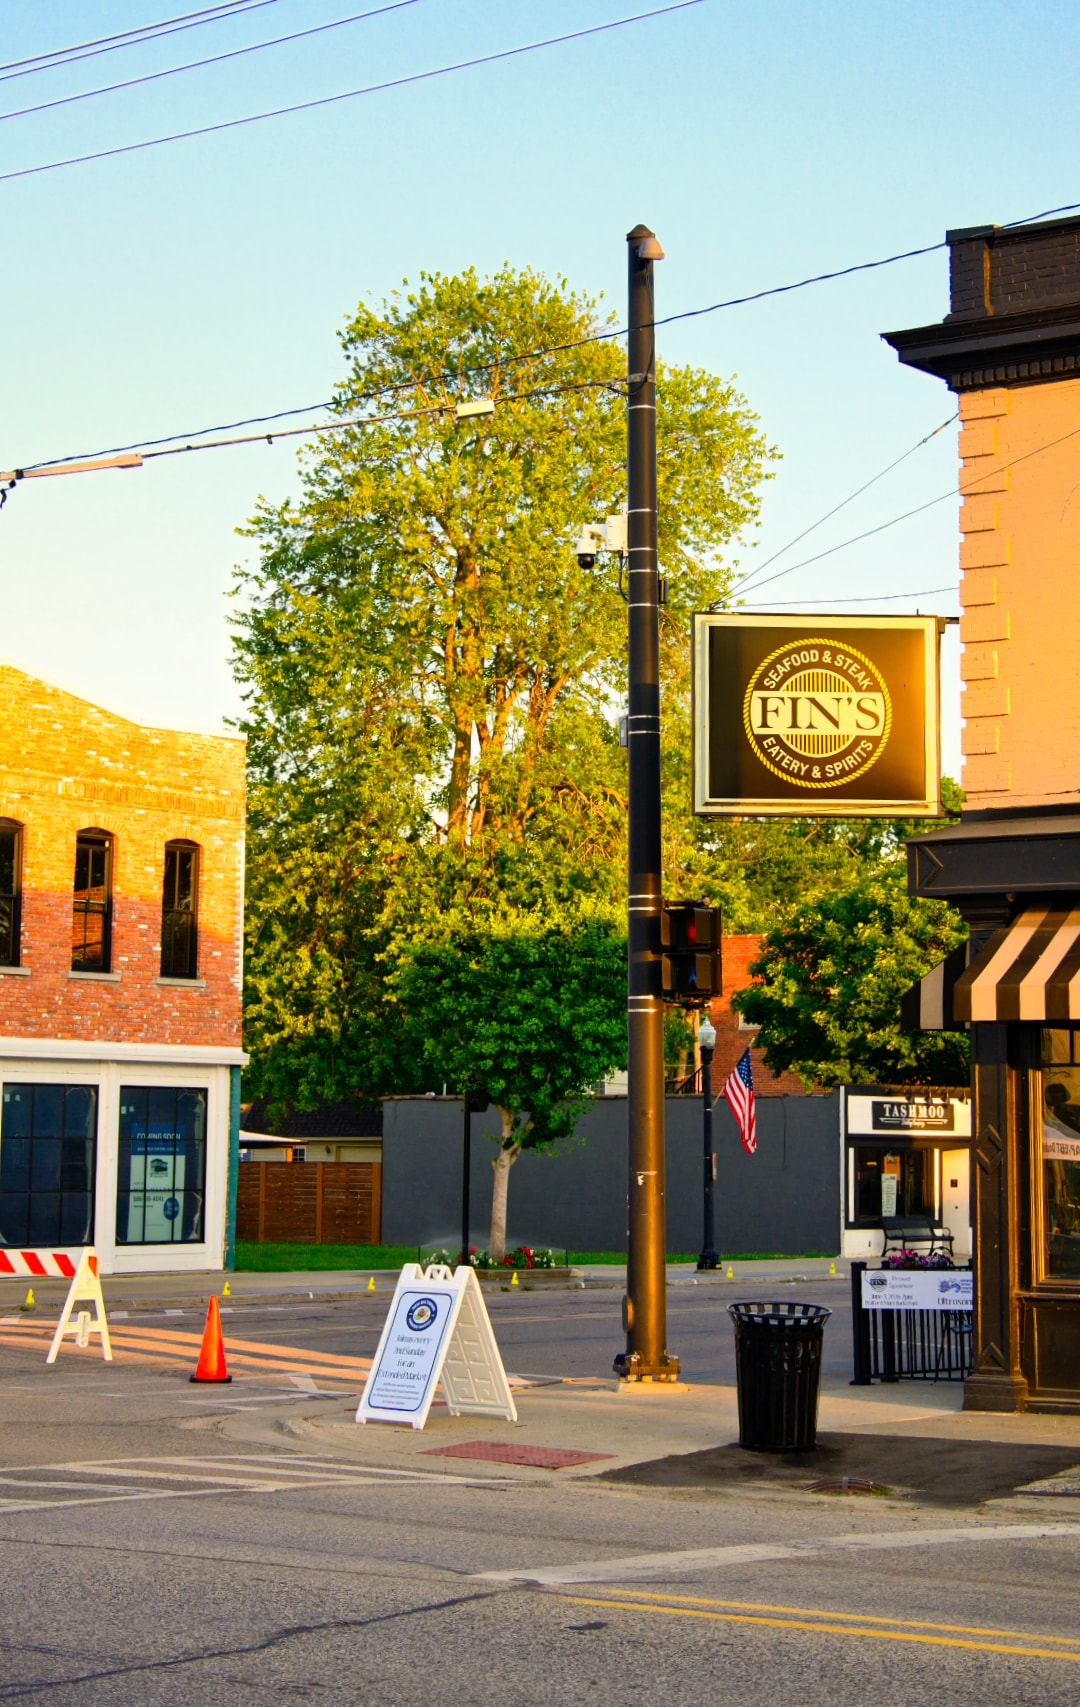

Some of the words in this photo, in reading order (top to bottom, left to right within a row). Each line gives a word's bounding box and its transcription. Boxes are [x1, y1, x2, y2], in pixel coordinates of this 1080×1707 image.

[763, 649, 819, 689] SEAFOOD
[822, 650, 832, 664] &
[834, 654, 874, 690] STEAK
[757, 696, 880, 731] FIN'S
[762, 736, 809, 776] EATERY
[811, 765, 822, 778] &
[825, 740, 873, 777] SPIRITS
[883, 1103, 944, 1118] TASHMOO
